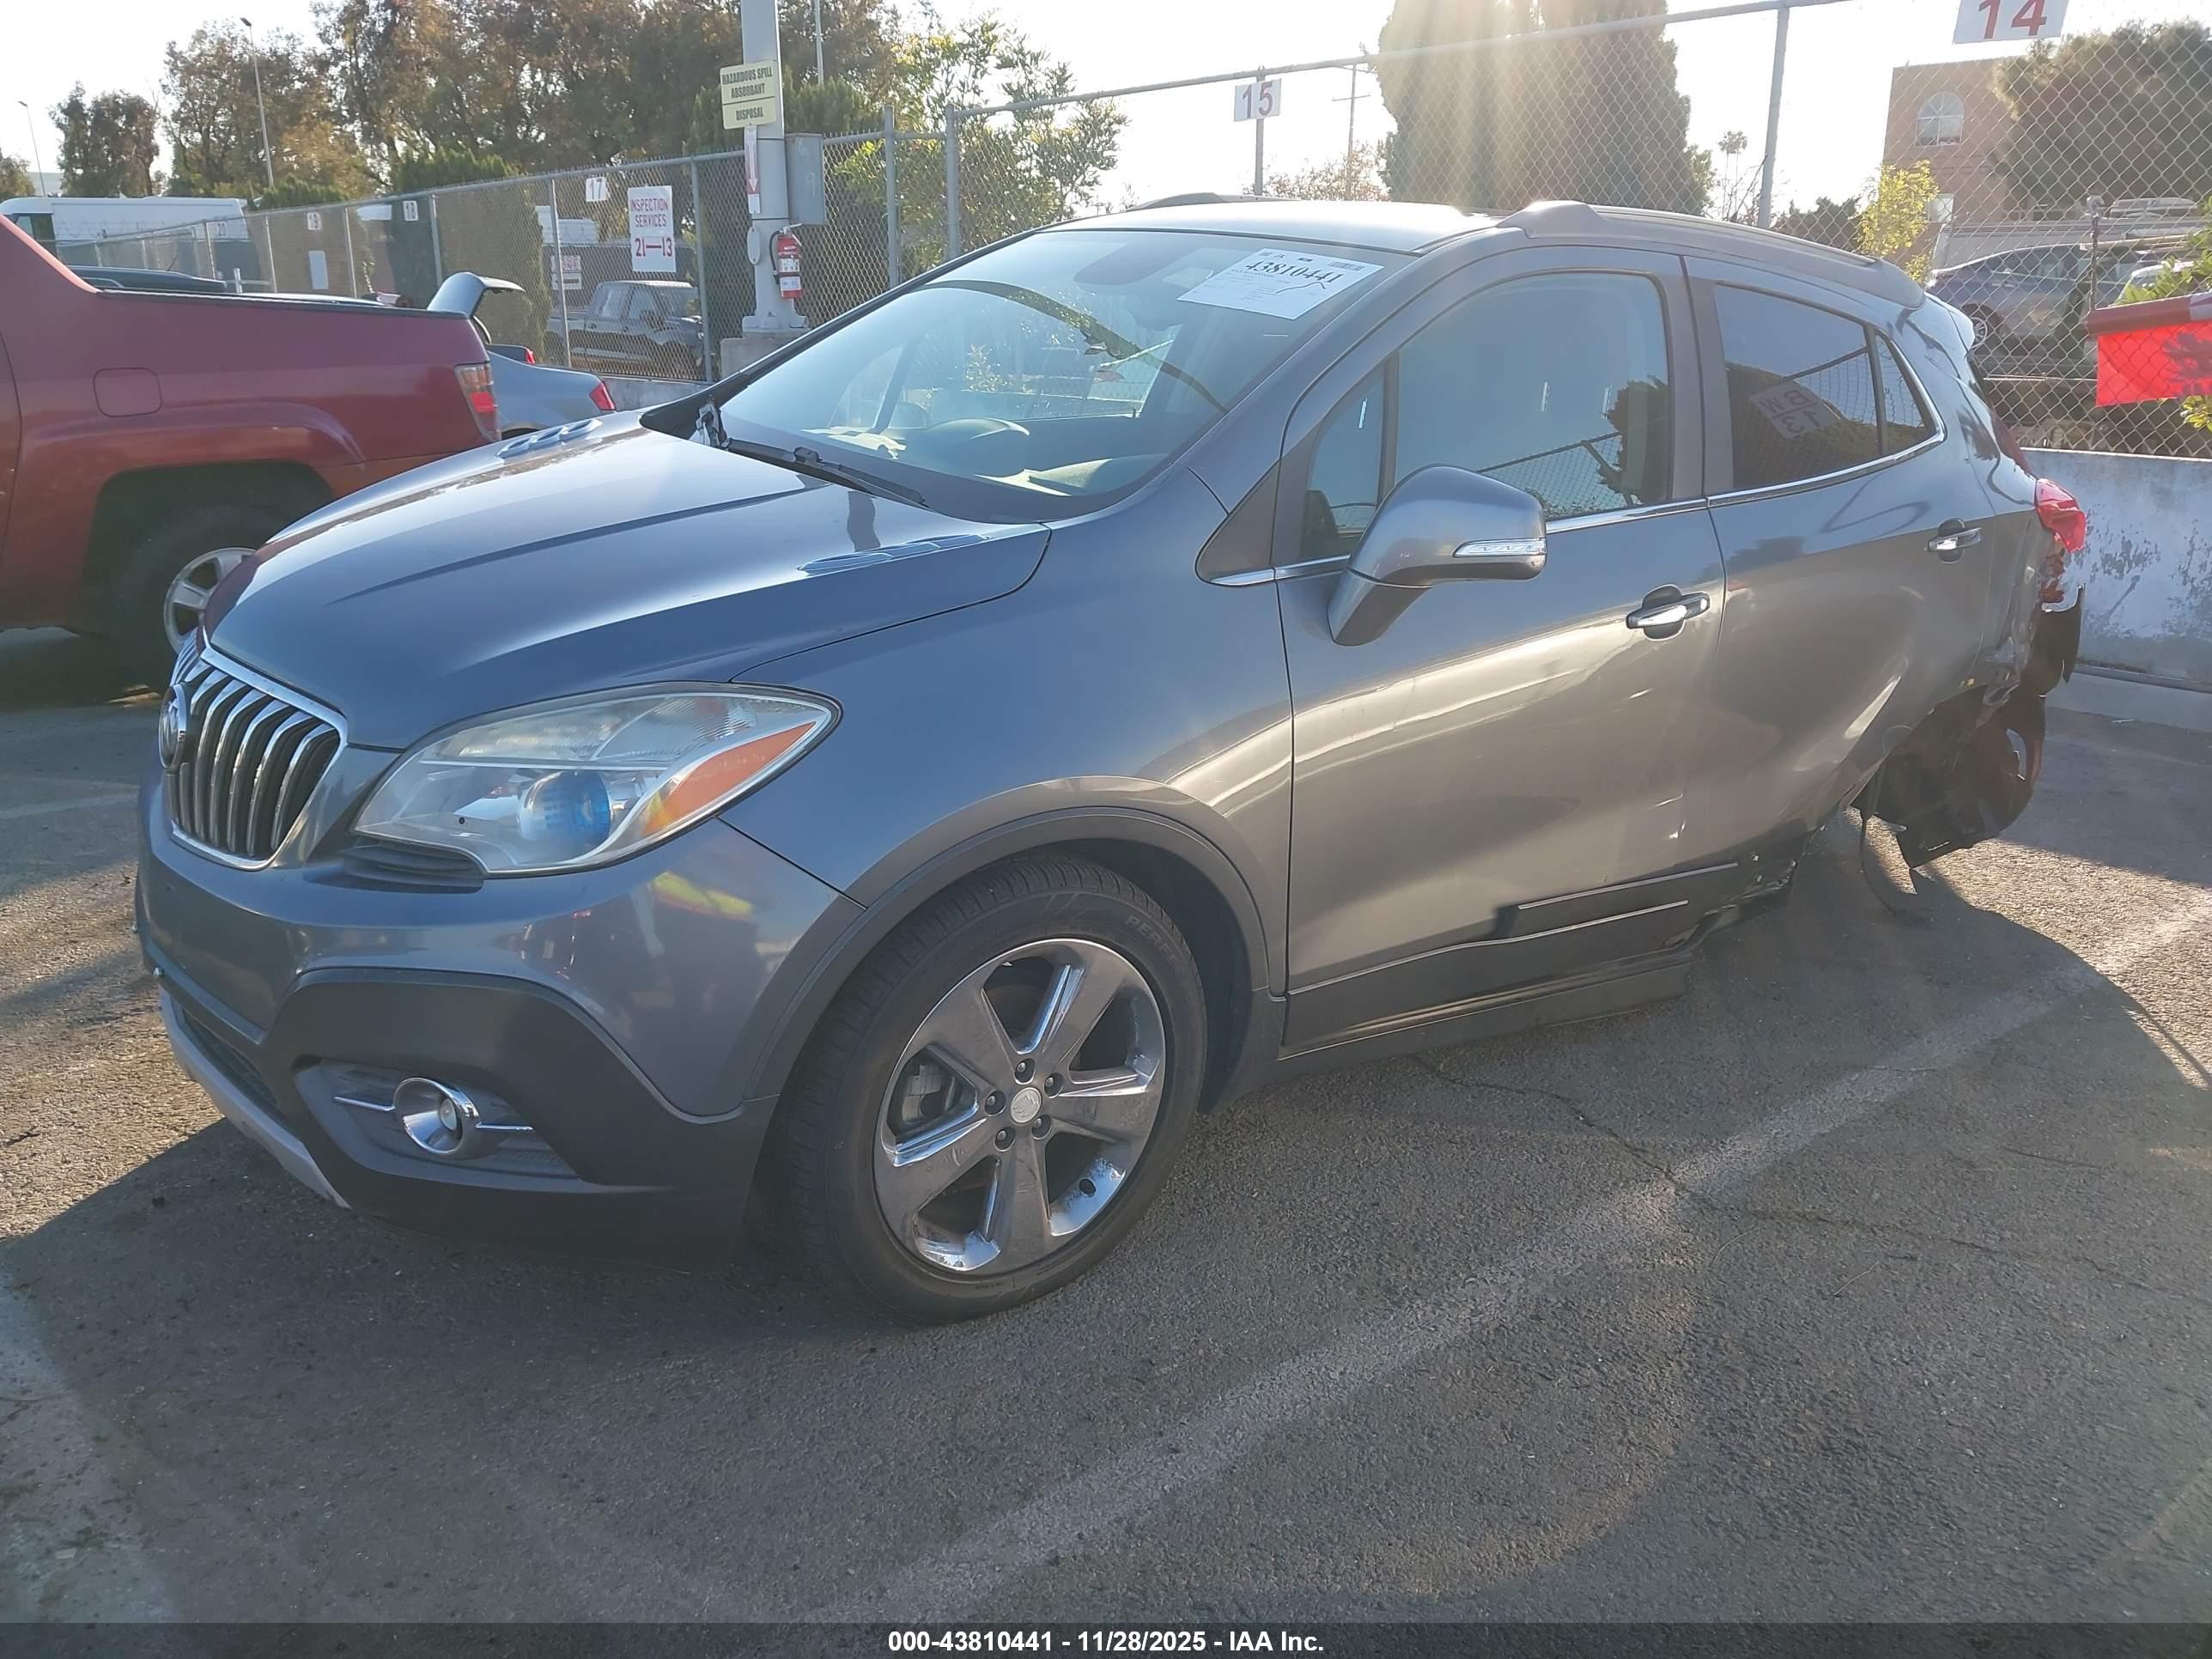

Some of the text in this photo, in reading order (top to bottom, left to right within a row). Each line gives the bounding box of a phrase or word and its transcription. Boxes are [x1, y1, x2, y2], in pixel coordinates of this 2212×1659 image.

[1978, 0, 2047, 40] 14
[721, 66, 772, 85] HAZARDOUS SPILL
[731, 83, 765, 98] ABSORBANT
[1243, 81, 1273, 118] 15
[736, 106, 763, 120] DISPOSAL
[630, 198, 668, 211] INSPECTION
[635, 213, 666, 228] SERVICES
[1244, 260, 1344, 283] 43810441
